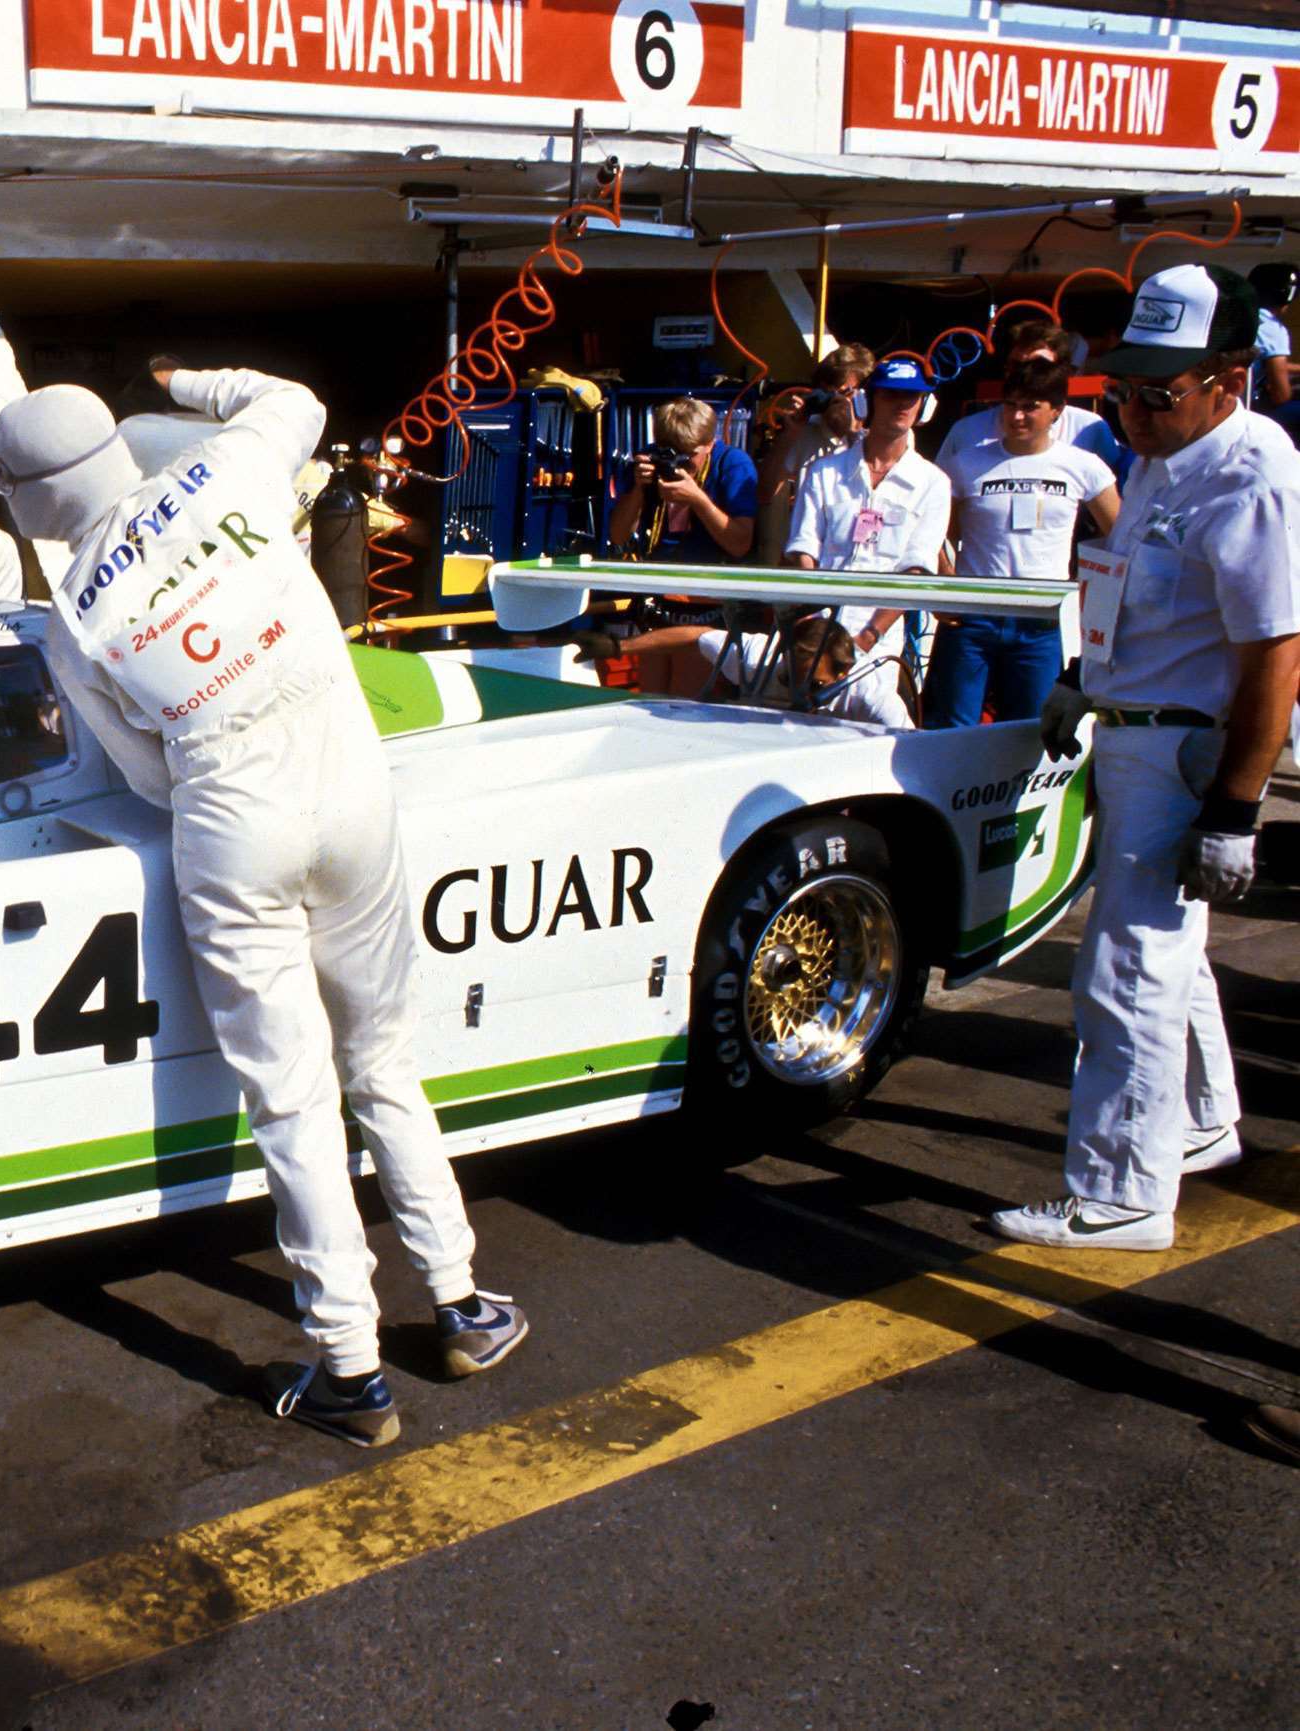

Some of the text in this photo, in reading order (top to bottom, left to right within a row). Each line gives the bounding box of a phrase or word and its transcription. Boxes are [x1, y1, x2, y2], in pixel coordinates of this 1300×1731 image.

[91, 0, 523, 84] LANCIA-MARTINI
[634, 9, 677, 91] 6
[893, 44, 1169, 136] LANCIA-MARTINI
[1228, 72, 1262, 140] 5
[131, 624, 159, 653] 24
[158, 606, 189, 634] HEURES
[197, 576, 219, 602] MANS
[182, 622, 221, 664] C
[161, 619, 287, 722] Scotchlite 3M
